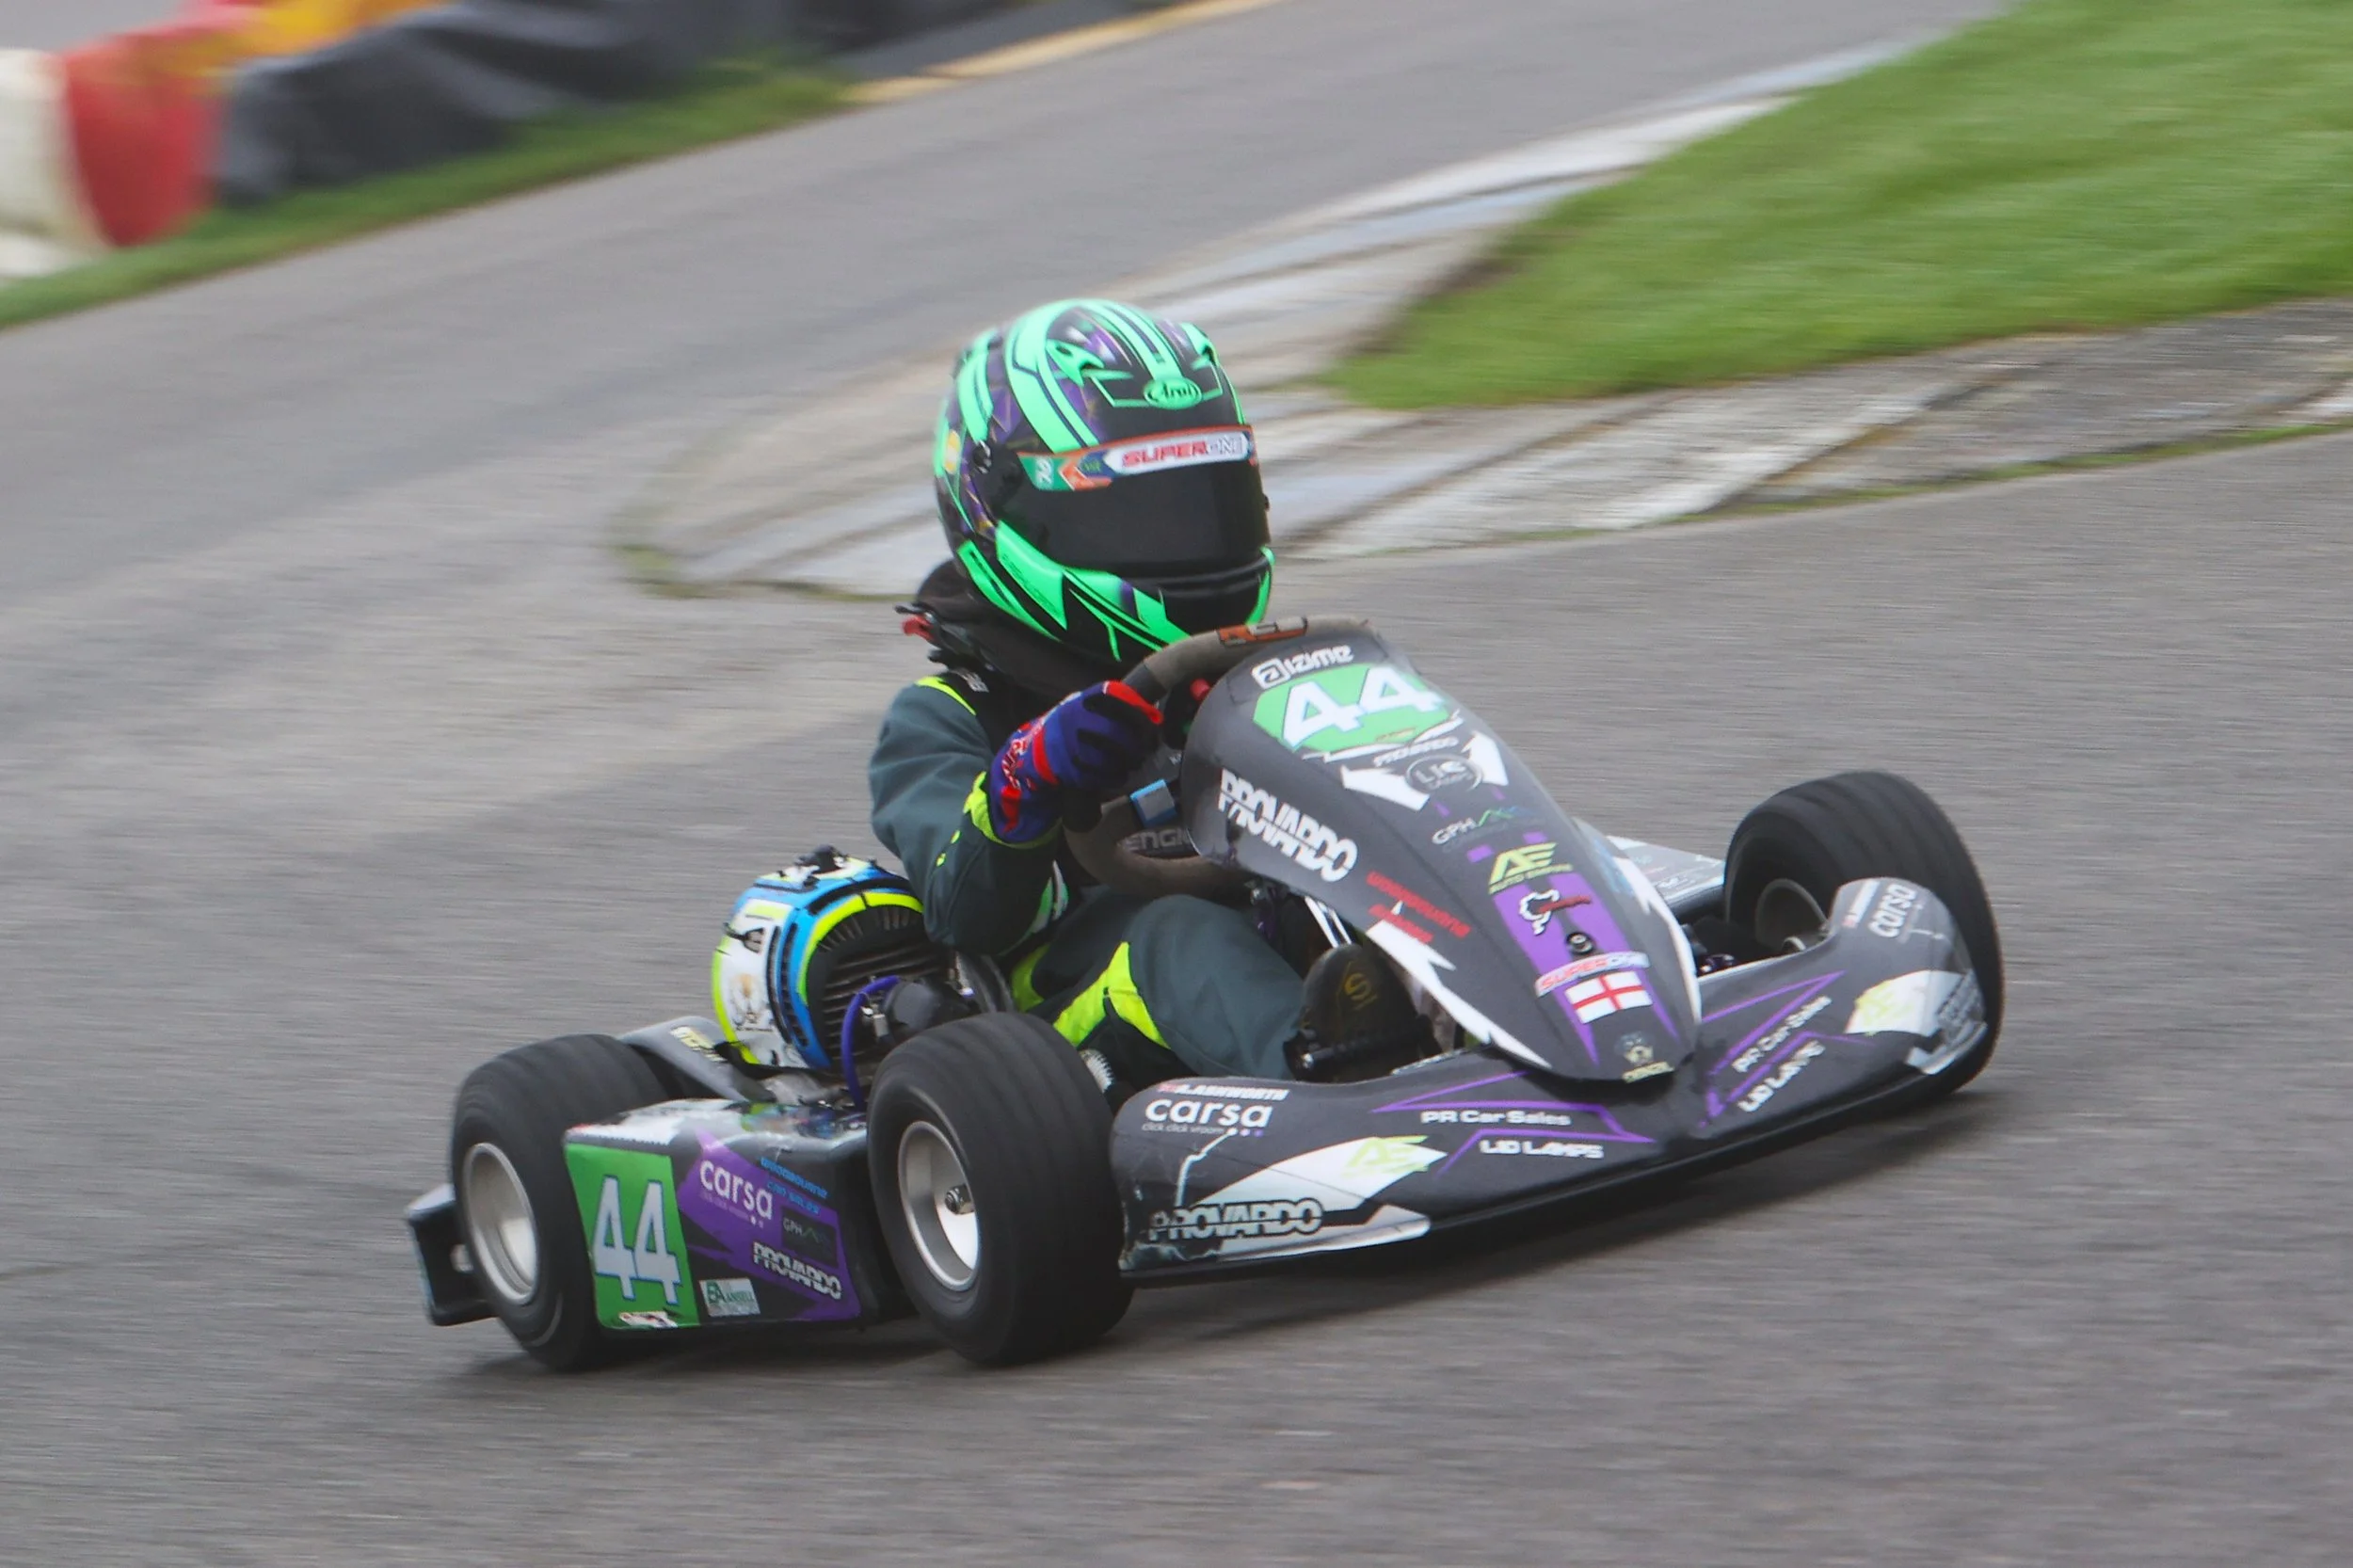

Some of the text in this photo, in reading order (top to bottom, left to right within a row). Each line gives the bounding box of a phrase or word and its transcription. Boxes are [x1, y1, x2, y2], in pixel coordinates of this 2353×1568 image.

[1281, 664, 1447, 748] 44
[1218, 768, 1358, 883] PROVARDO
[1144, 1098, 1273, 1128] carsa
[1419, 1109, 1459, 1125] PR
[1460, 1109, 1506, 1124] Car
[699, 1159, 774, 1221] carsa
[1149, 1197, 1322, 1241] PROVARDO
[591, 1175, 685, 1305] 44
[753, 1241, 843, 1301] PROVARDO
